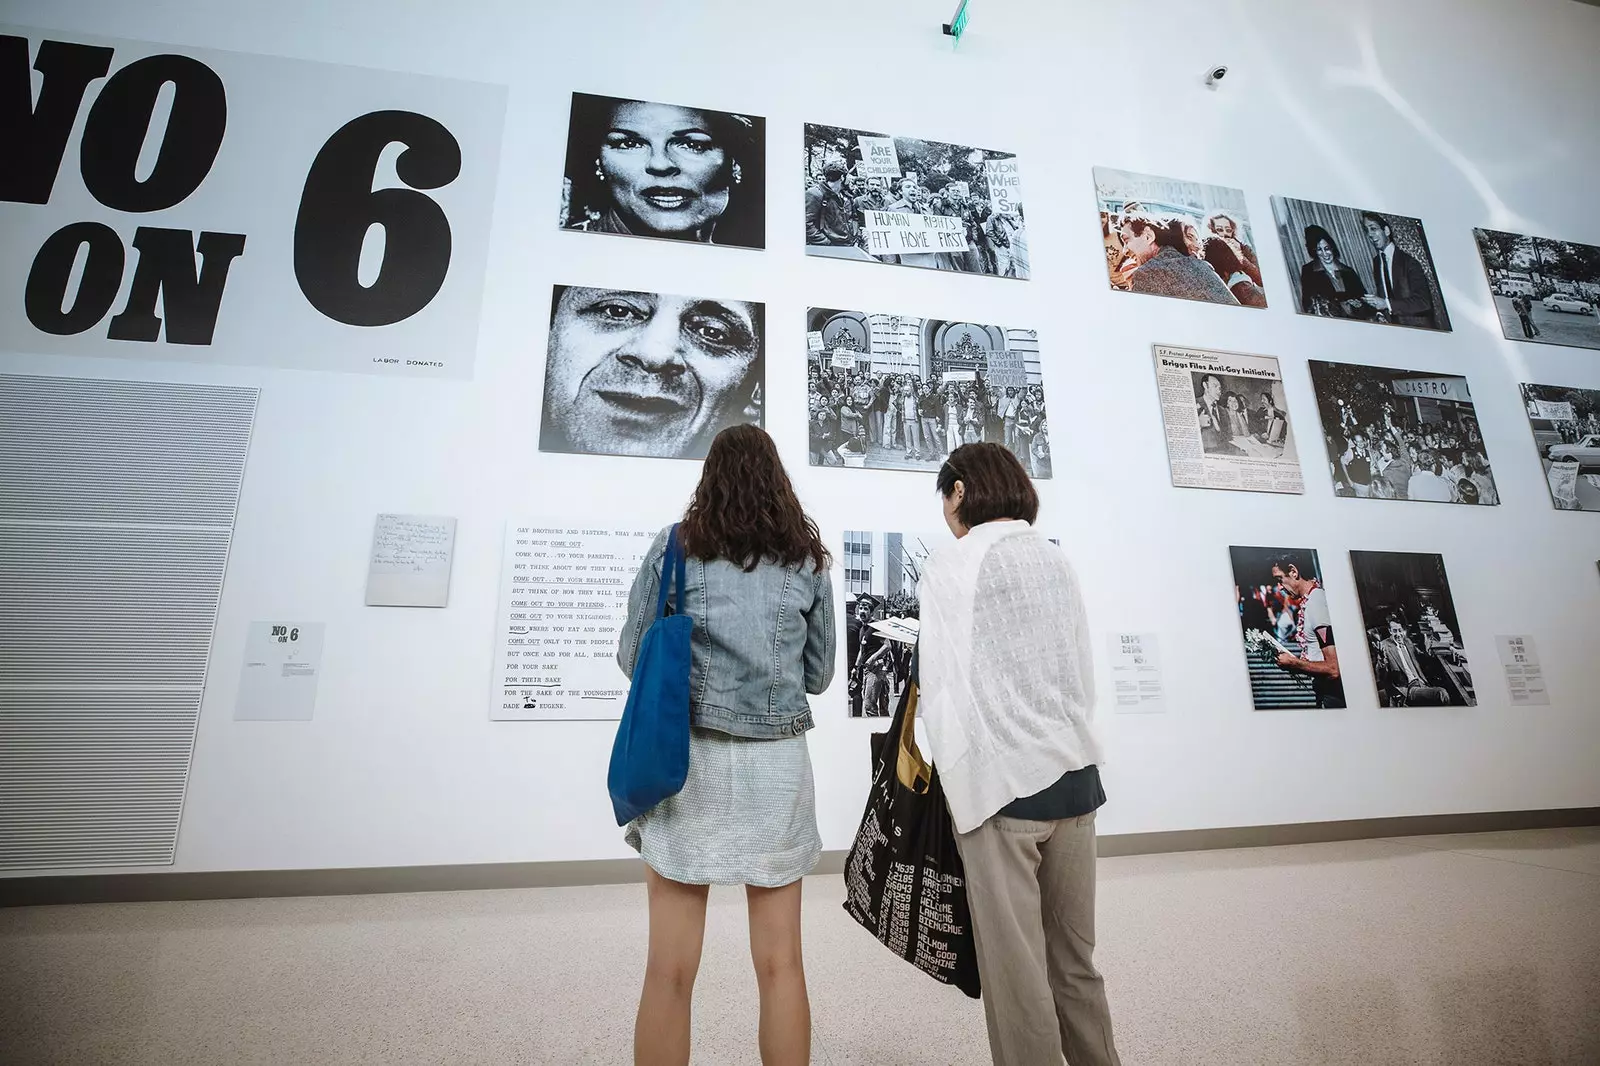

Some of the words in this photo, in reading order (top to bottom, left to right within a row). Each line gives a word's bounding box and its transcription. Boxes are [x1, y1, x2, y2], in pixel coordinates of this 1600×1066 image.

[870, 146, 892, 156] ARE
[870, 157, 892, 165] YOUR
[993, 188, 1008, 199] DO
[293, 110, 462, 327] 6
[874, 212, 910, 227] HUMAN
[923, 216, 956, 230] RIGHTS
[872, 231, 891, 249] AT
[900, 230, 930, 248] HOME
[938, 232, 964, 248] FIRST
[24, 221, 246, 346] ON
[372, 357, 400, 365] LABOR
[406, 360, 444, 368] DONATED
[1162, 358, 1188, 369] Briggs
[1190, 362, 1207, 370] Files
[1208, 364, 1240, 375] Anti-Gay
[1242, 367, 1276, 378] Initiative
[271, 626, 287, 636] NO
[290, 628, 299, 642] 6
[919, 905, 954, 924] LANDING
[918, 914, 964, 936] BIENVENUE
[916, 940, 932, 955] ALL
[936, 950, 958, 960] GOOD
[917, 932, 948, 951] WELKOM
[915, 948, 956, 970] SUNSHINE
